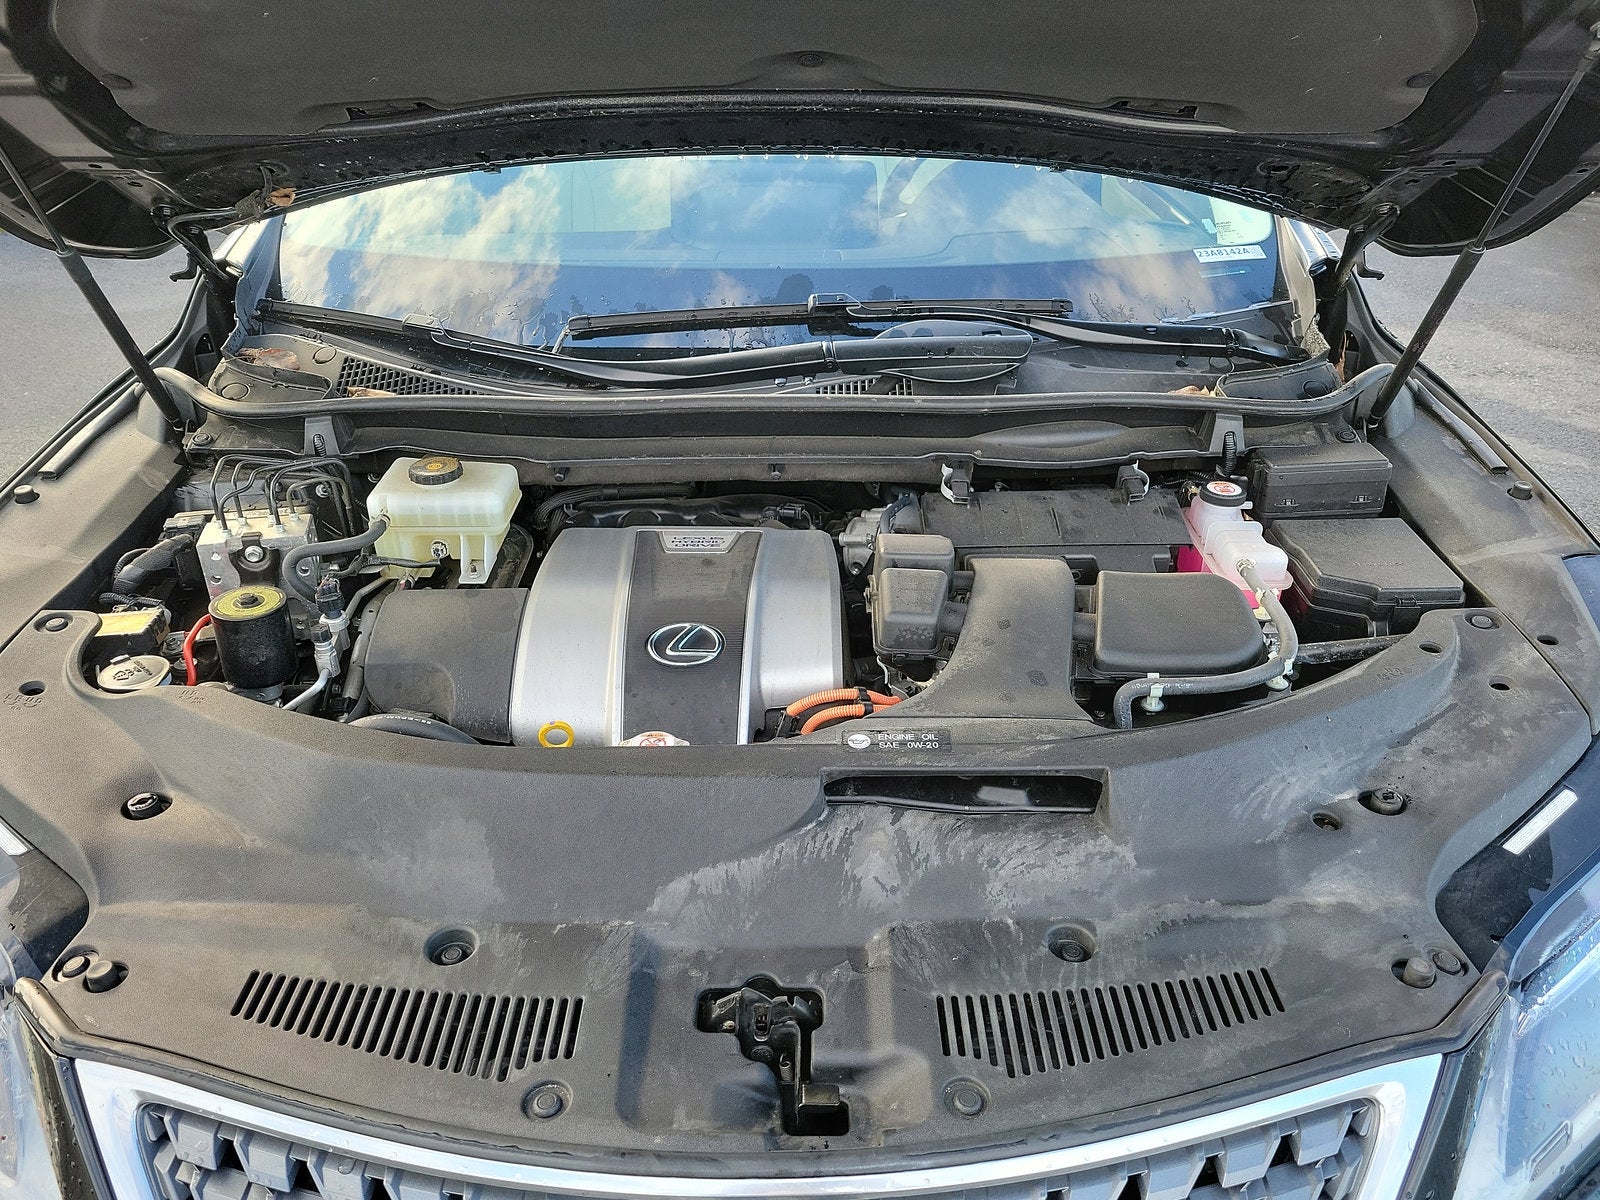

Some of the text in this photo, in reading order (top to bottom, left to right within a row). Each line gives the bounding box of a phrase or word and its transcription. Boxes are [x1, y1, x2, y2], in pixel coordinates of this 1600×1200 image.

[1196, 247, 1250, 258] 23A8142A
[877, 733, 939, 741] ENGINE OIL
[878, 741, 939, 749] SAE 0W-20
